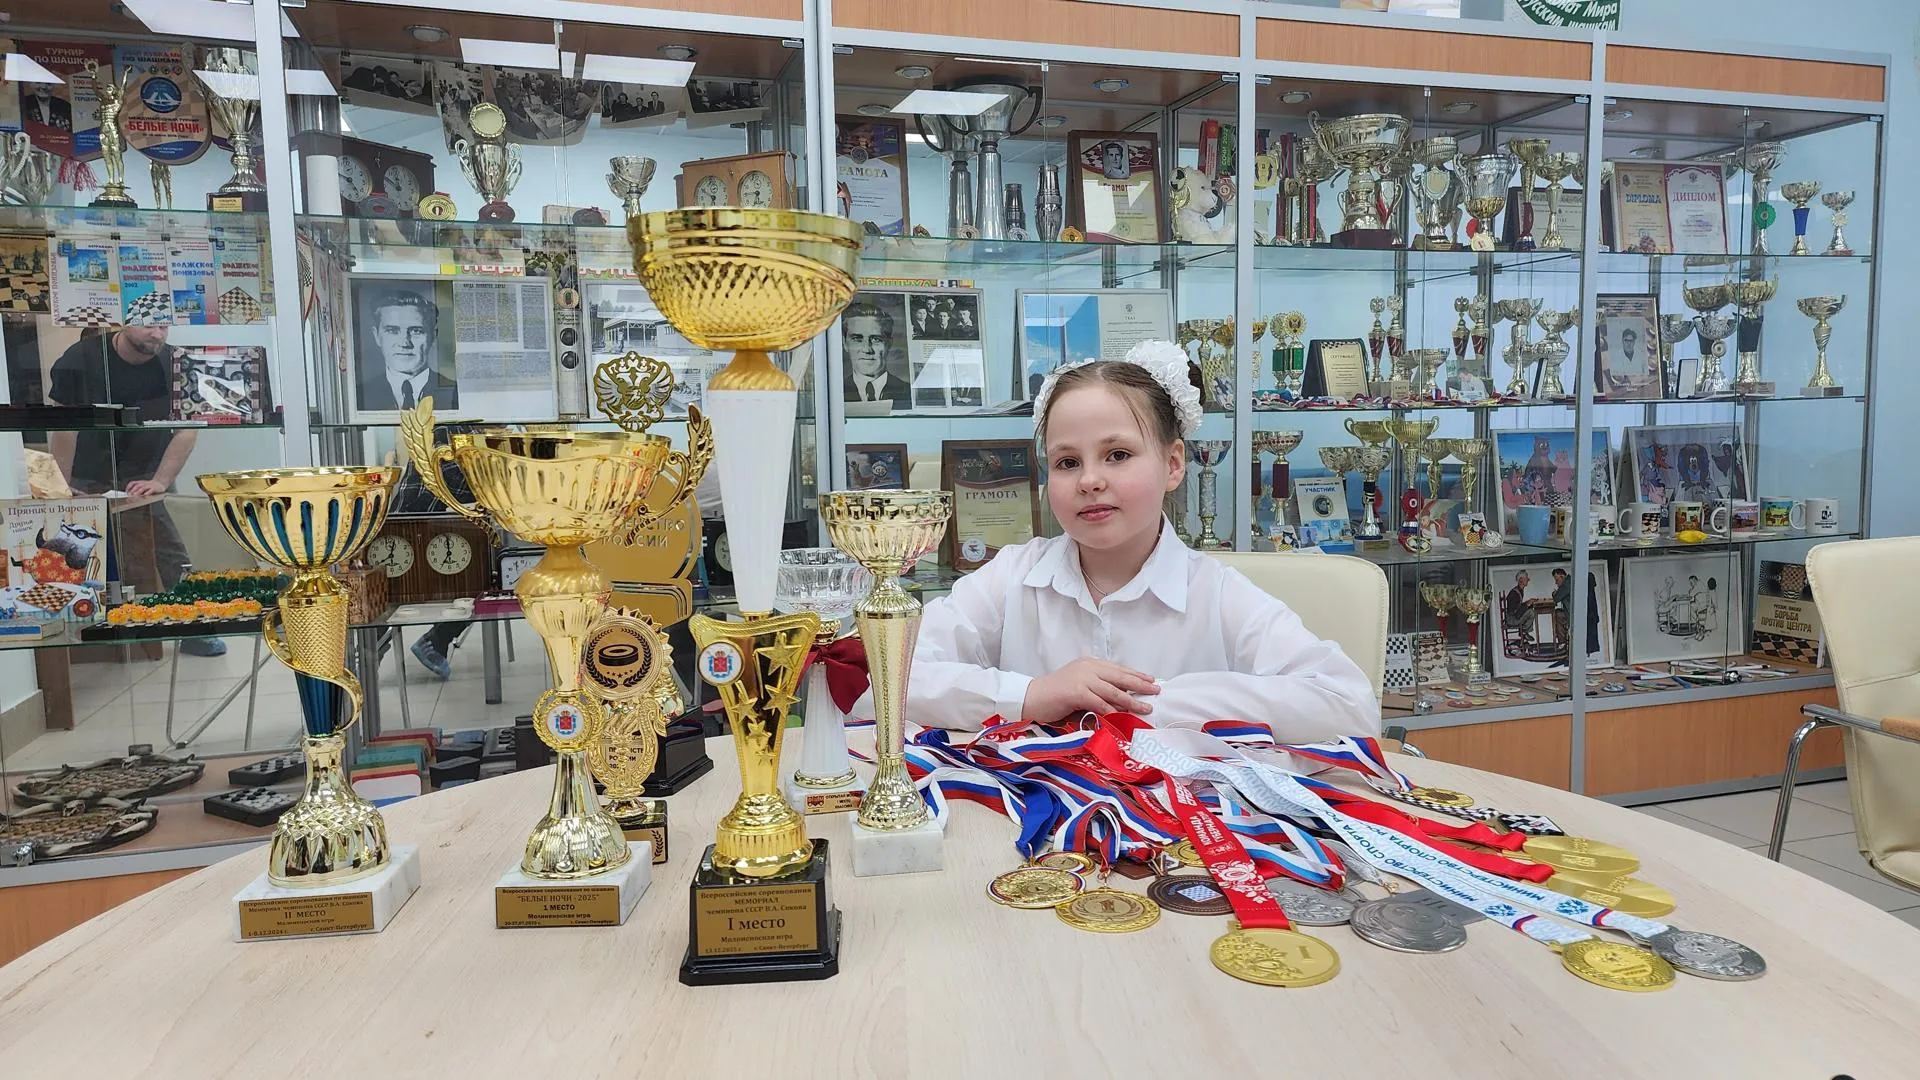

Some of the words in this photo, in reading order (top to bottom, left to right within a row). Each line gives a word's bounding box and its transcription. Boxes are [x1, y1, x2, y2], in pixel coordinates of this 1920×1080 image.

[1521, 0, 1565, 27] усским
[1582, 0, 1618, 21] Мира
[45, 48, 85, 56] ТУРНИР
[839, 166, 889, 178] РАМОТА
[1625, 193, 1662, 204] DIPLOMA
[1672, 191, 1717, 202] ДИПЛОМ
[171, 261, 214, 269] ВОЛЖСКОЕ
[965, 490, 1019, 500] ГРАМОТА
[8, 506, 47, 517] Пряник
[57, 504, 100, 514] Вареник
[601, 533, 668, 548] РОСИИ
[1774, 610, 1799, 621] БОРЬБА
[1761, 616, 1784, 629] ПРОТИВ
[1786, 620, 1812, 633] ЦЕНТРА
[1189, 815, 1213, 846] КОМАНДА
[1341, 825, 1386, 859] СПОРТА
[1389, 835, 1438, 863] СПОРТА
[1384, 857, 1479, 902] МИНИСТЕРСТВО
[1437, 859, 1546, 901] МИНИСТЕРСТВО
[549, 894, 572, 902] НОЧИ
[700, 890, 756, 899] Всероссийские
[758, 888, 812, 897] соревнования
[243, 899, 288, 907] Всероссийские
[289, 896, 333, 905] соревнования
[735, 897, 779, 905] МЕМОРИАЛ
[285, 911, 292, 919] II
[296, 910, 326, 918] МЕСТО
[706, 907, 744, 915] чемпиона
[315, 924, 368, 932] Санкт-Петербург
[738, 918, 786, 931] место
[721, 934, 775, 943] Молниеносная
[776, 933, 794, 941] игра
[758, 943, 809, 951] Санкт-Петербург
